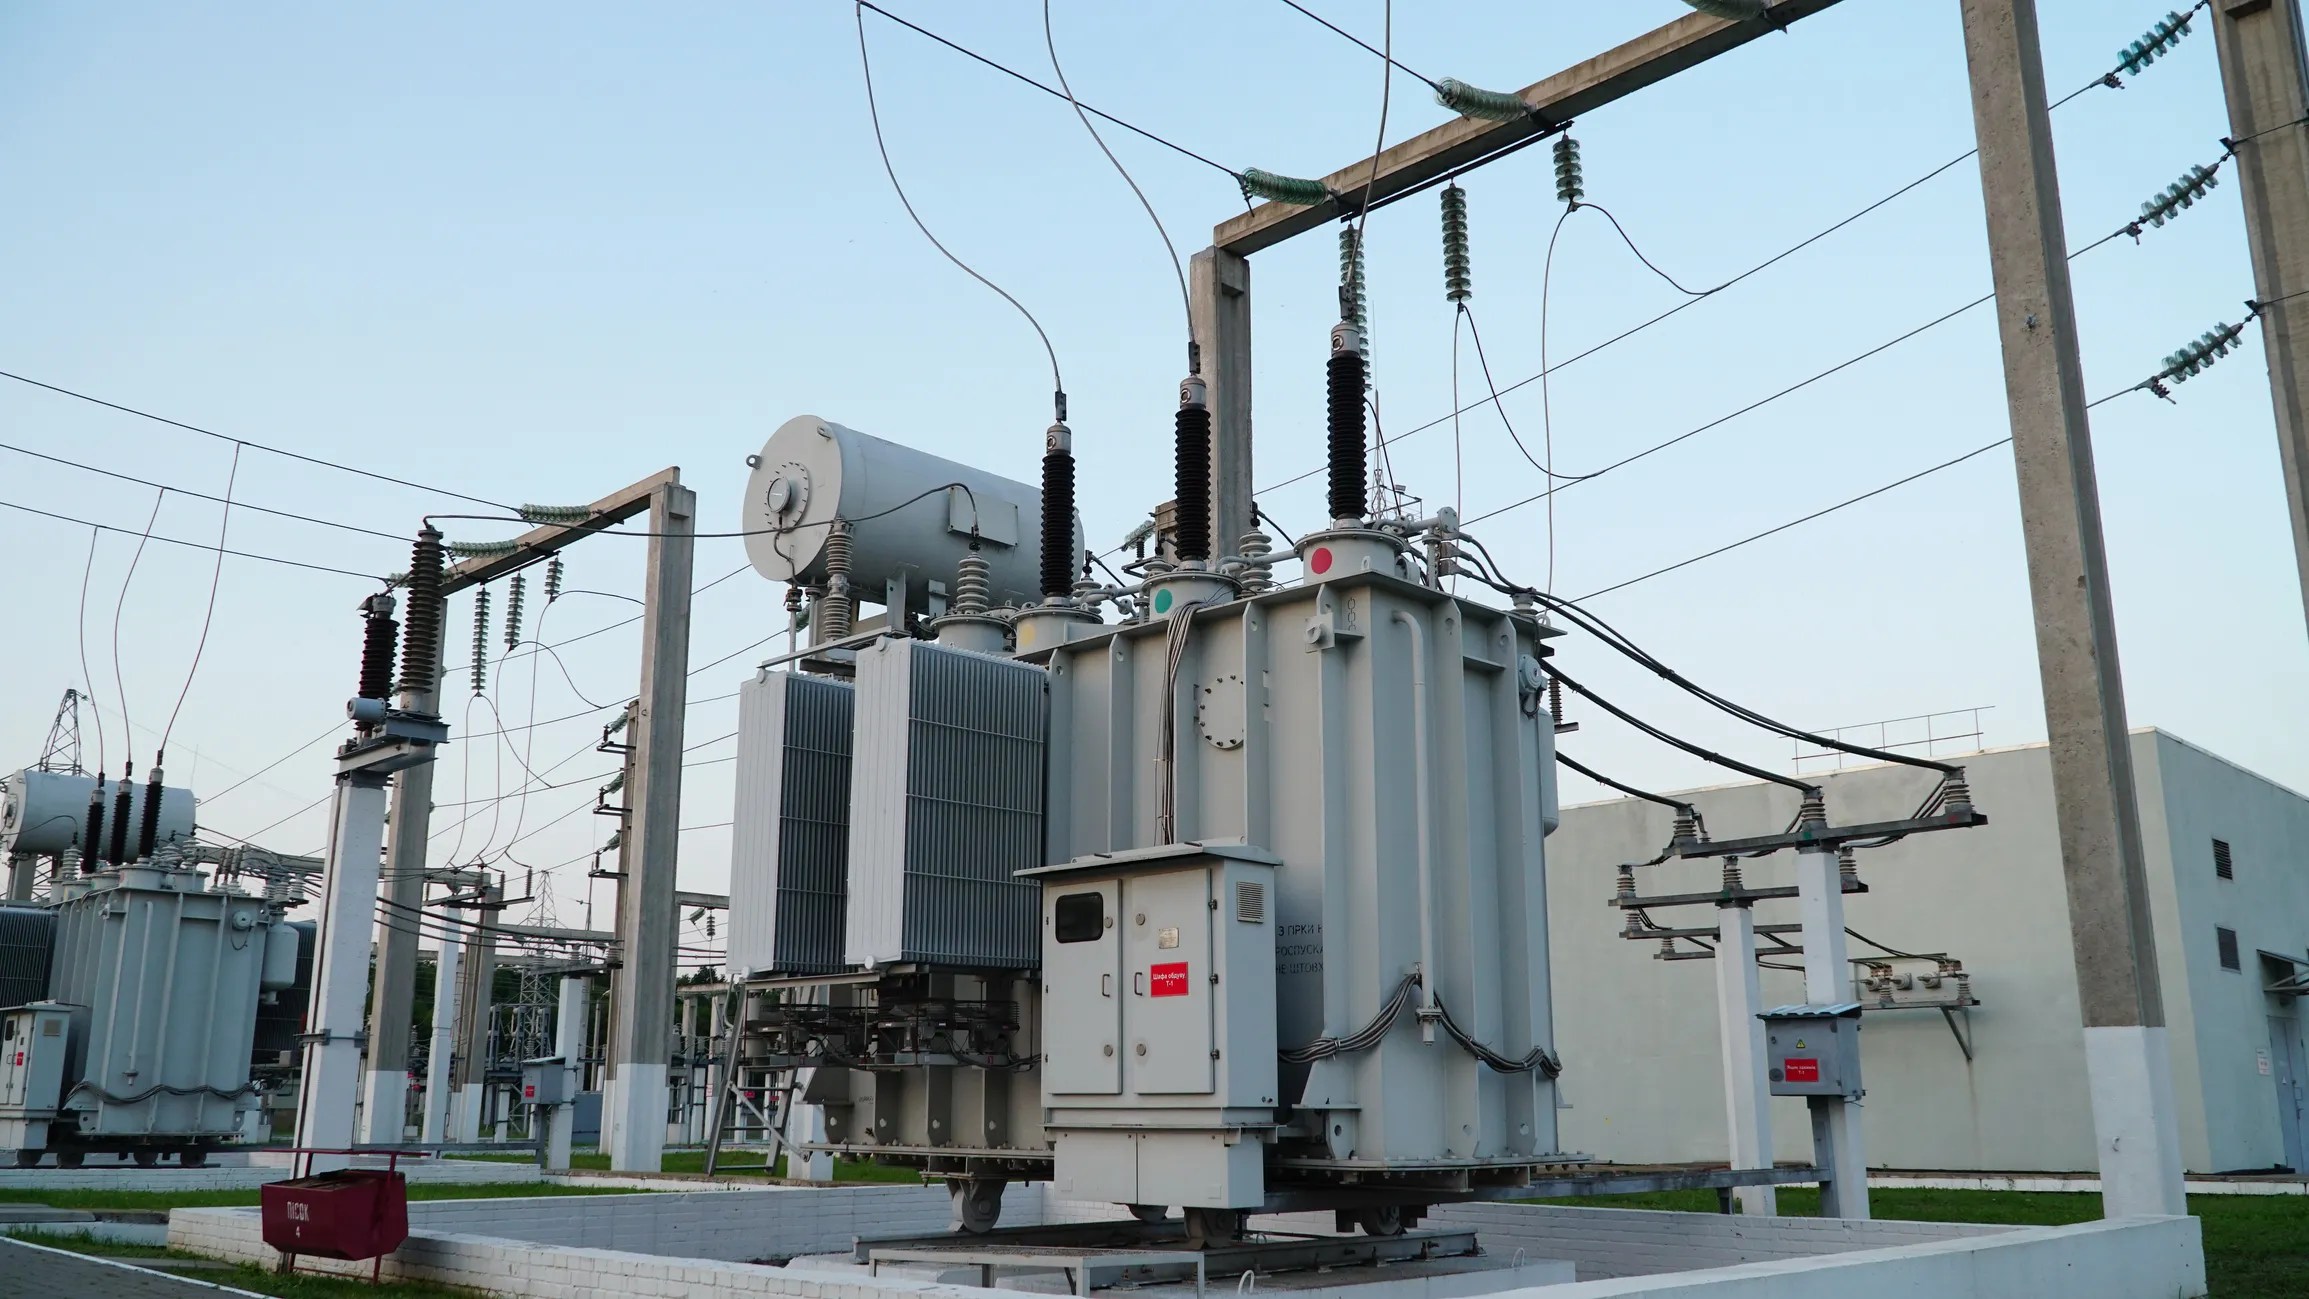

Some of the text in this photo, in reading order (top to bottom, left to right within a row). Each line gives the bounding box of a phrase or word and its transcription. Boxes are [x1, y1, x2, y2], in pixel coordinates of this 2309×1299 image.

[1278, 925, 1285, 937] З
[1287, 924, 1314, 936] ГІРКИ
[1152, 973, 1167, 981] Шафа
[295, 1225, 301, 1238] 4
